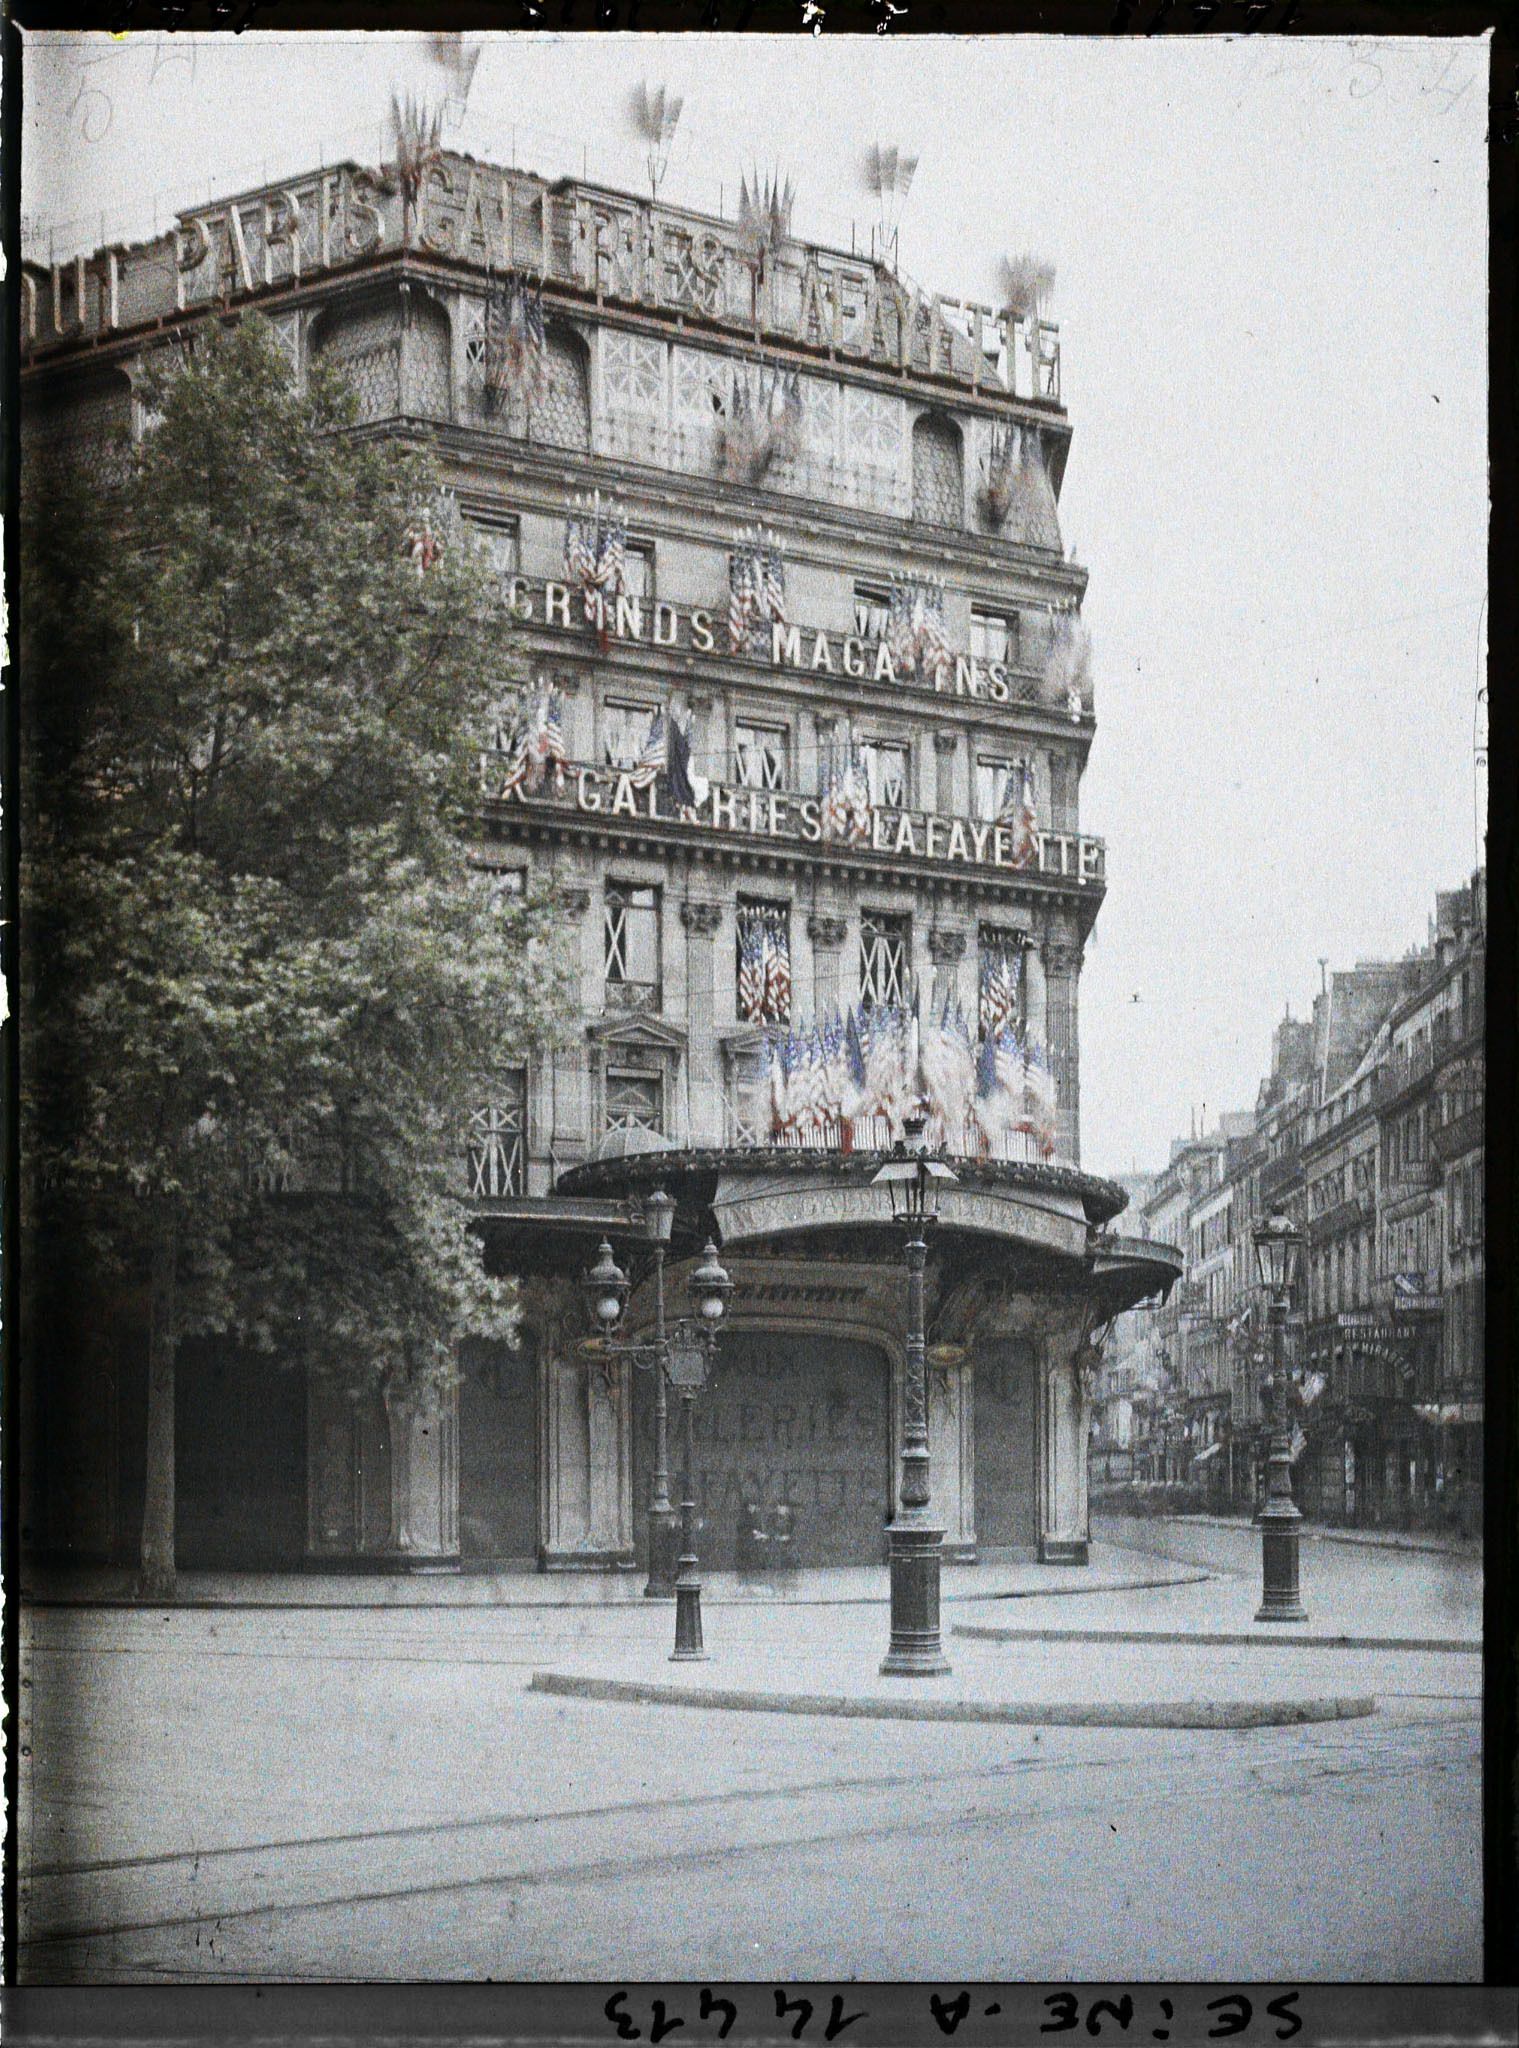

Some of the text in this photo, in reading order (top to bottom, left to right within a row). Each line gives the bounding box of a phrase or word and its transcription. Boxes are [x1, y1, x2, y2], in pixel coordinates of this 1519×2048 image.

[176, 170, 388, 311] PARIS
[771, 621, 1010, 701] MAGAINS
[577, 770, 823, 842] GALRIES
[872, 804, 1101, 882] LAFAYETTE
